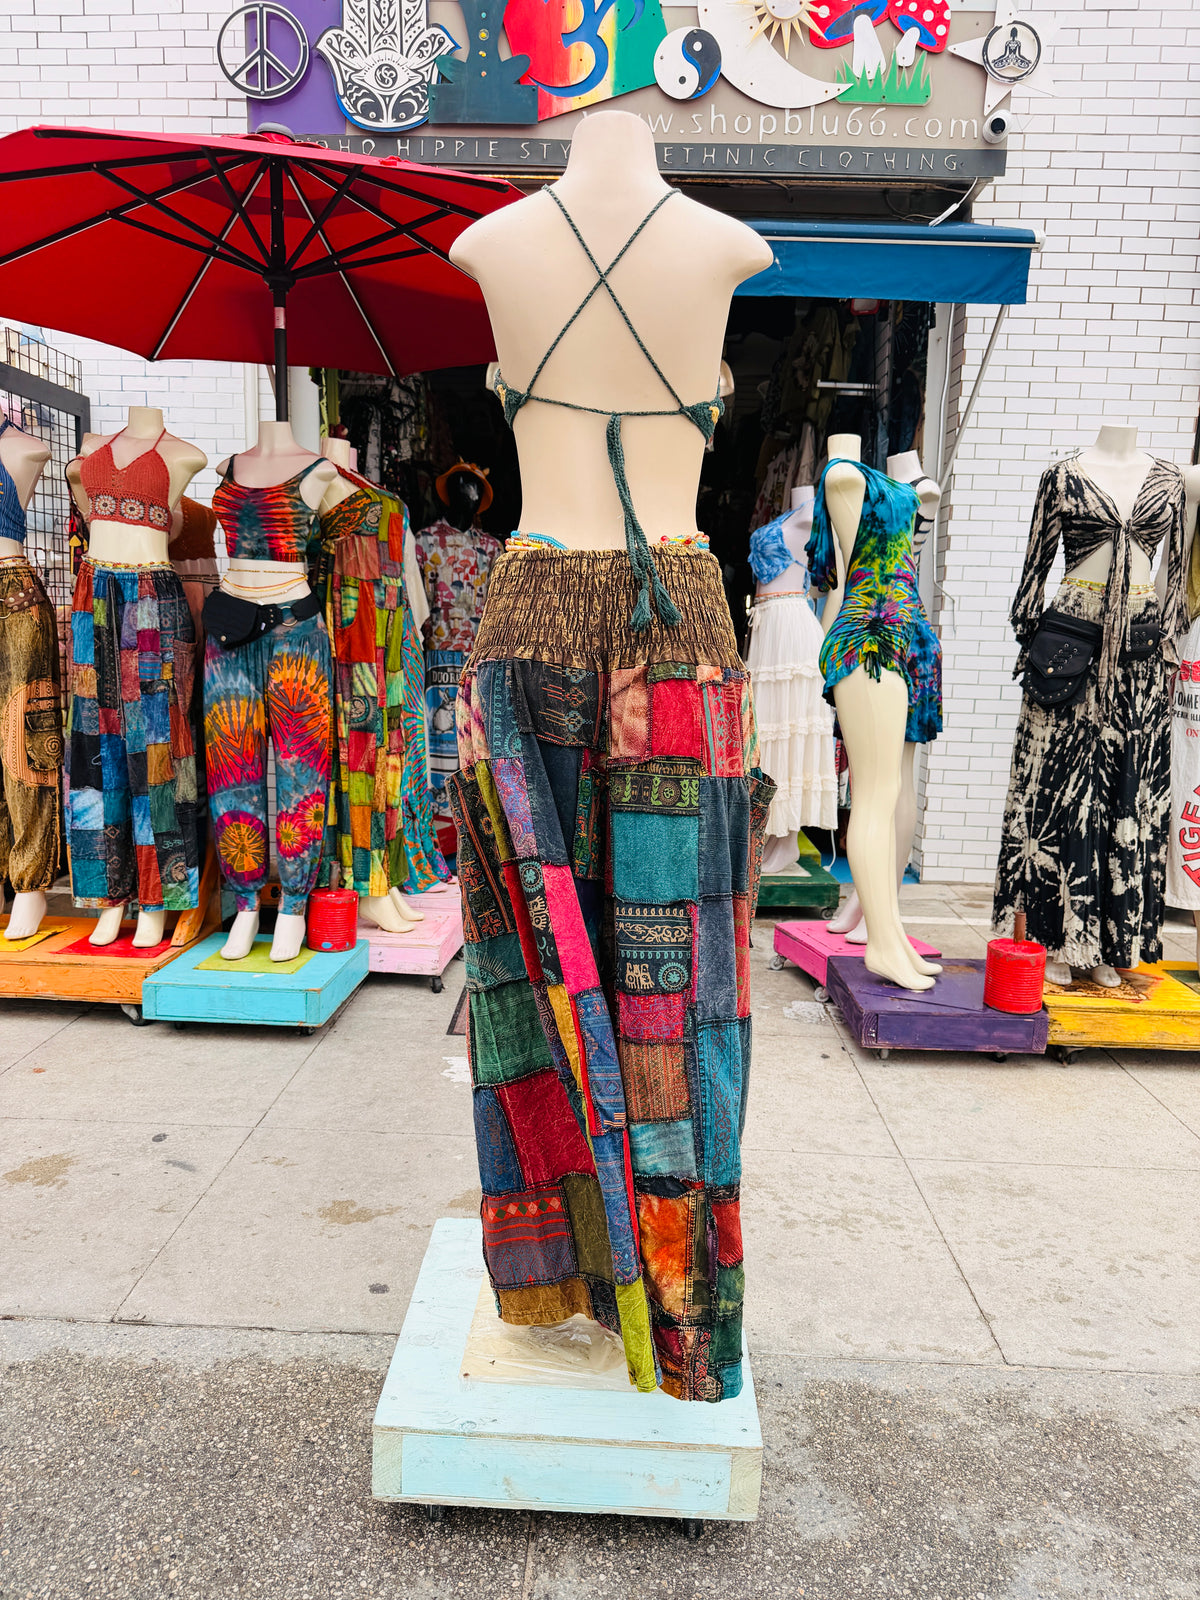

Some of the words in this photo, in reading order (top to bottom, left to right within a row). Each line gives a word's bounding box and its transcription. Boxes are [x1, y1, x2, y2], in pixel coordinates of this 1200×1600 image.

[583, 103, 979, 143] w.shopblu66.com
[397, 139, 499, 158] HIPPIE
[520, 142, 572, 160] STY
[664, 147, 776, 166] ETHNIC
[798, 149, 958, 171] CLOTHING
